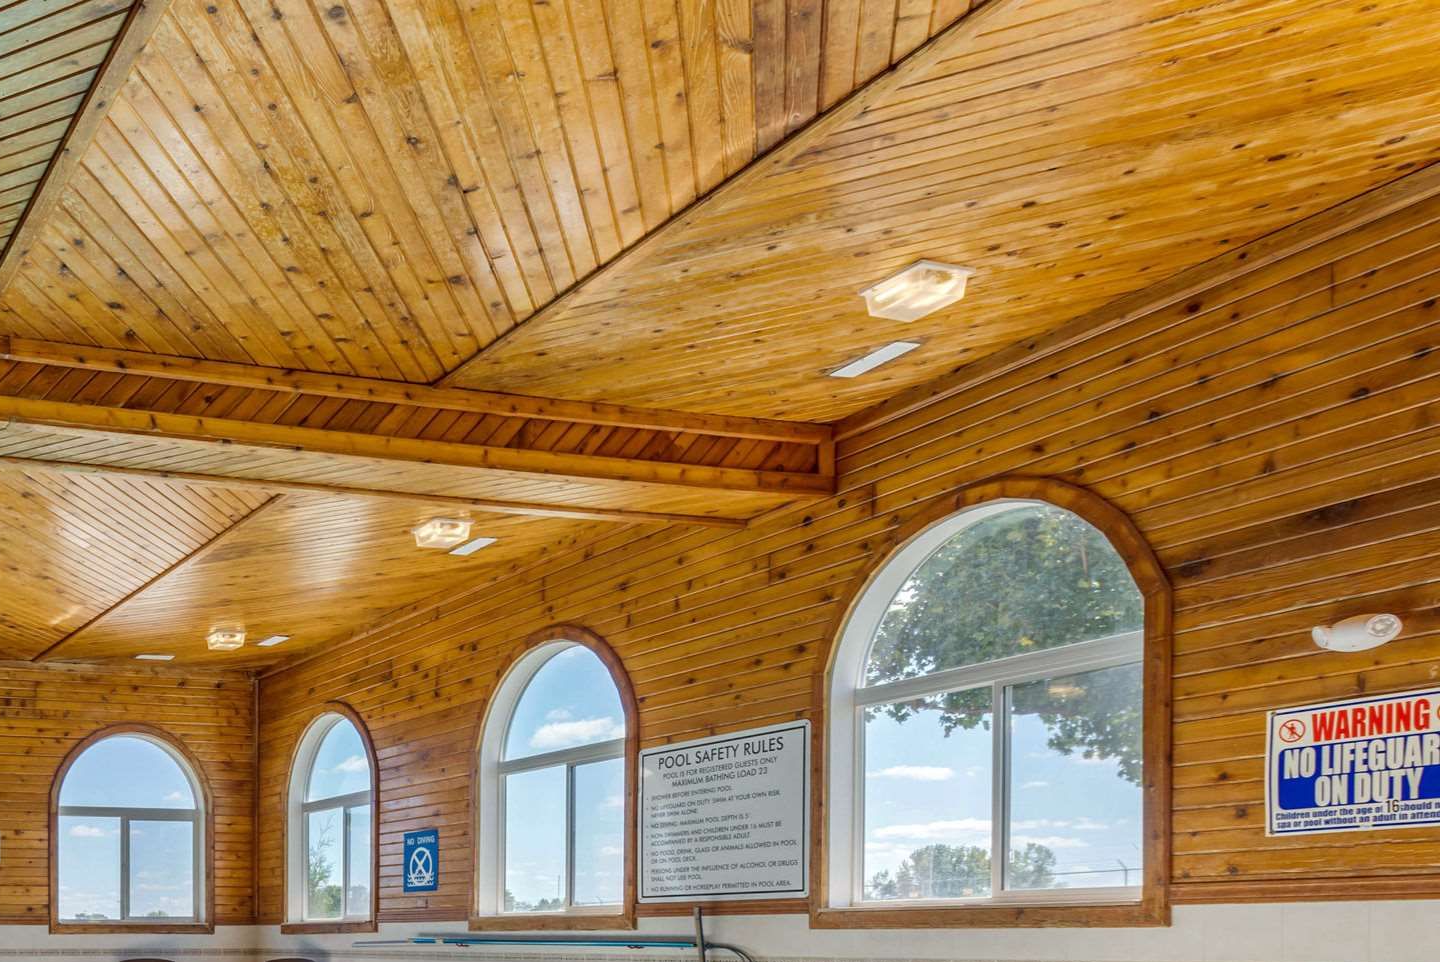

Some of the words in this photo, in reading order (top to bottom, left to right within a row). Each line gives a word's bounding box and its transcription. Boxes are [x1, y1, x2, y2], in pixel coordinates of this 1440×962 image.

[1312, 699, 1430, 742] WARNING
[658, 752, 691, 770] POOL
[695, 743, 739, 764] SAFETY
[743, 735, 784, 755] RULES
[1284, 747, 1316, 780] NO
[663, 771, 678, 780] POOL
[686, 768, 697, 776] FOR
[699, 762, 732, 774] REGISTERED
[734, 758, 757, 768] GUESTS
[759, 755, 777, 764] ONLY
[672, 776, 703, 787] MAXIMUM
[705, 771, 735, 782] BATHING
[736, 767, 756, 777] LOAD
[1314, 775, 1348, 806] ON
[1354, 767, 1424, 803] DUTY
[1276, 812, 1310, 820] Children
[1356, 807, 1373, 815] age
[1385, 800, 1400, 812] 16
[1304, 818, 1322, 827] pool
[1372, 814, 1396, 822] adult
[417, 835, 435, 845] DIVING
